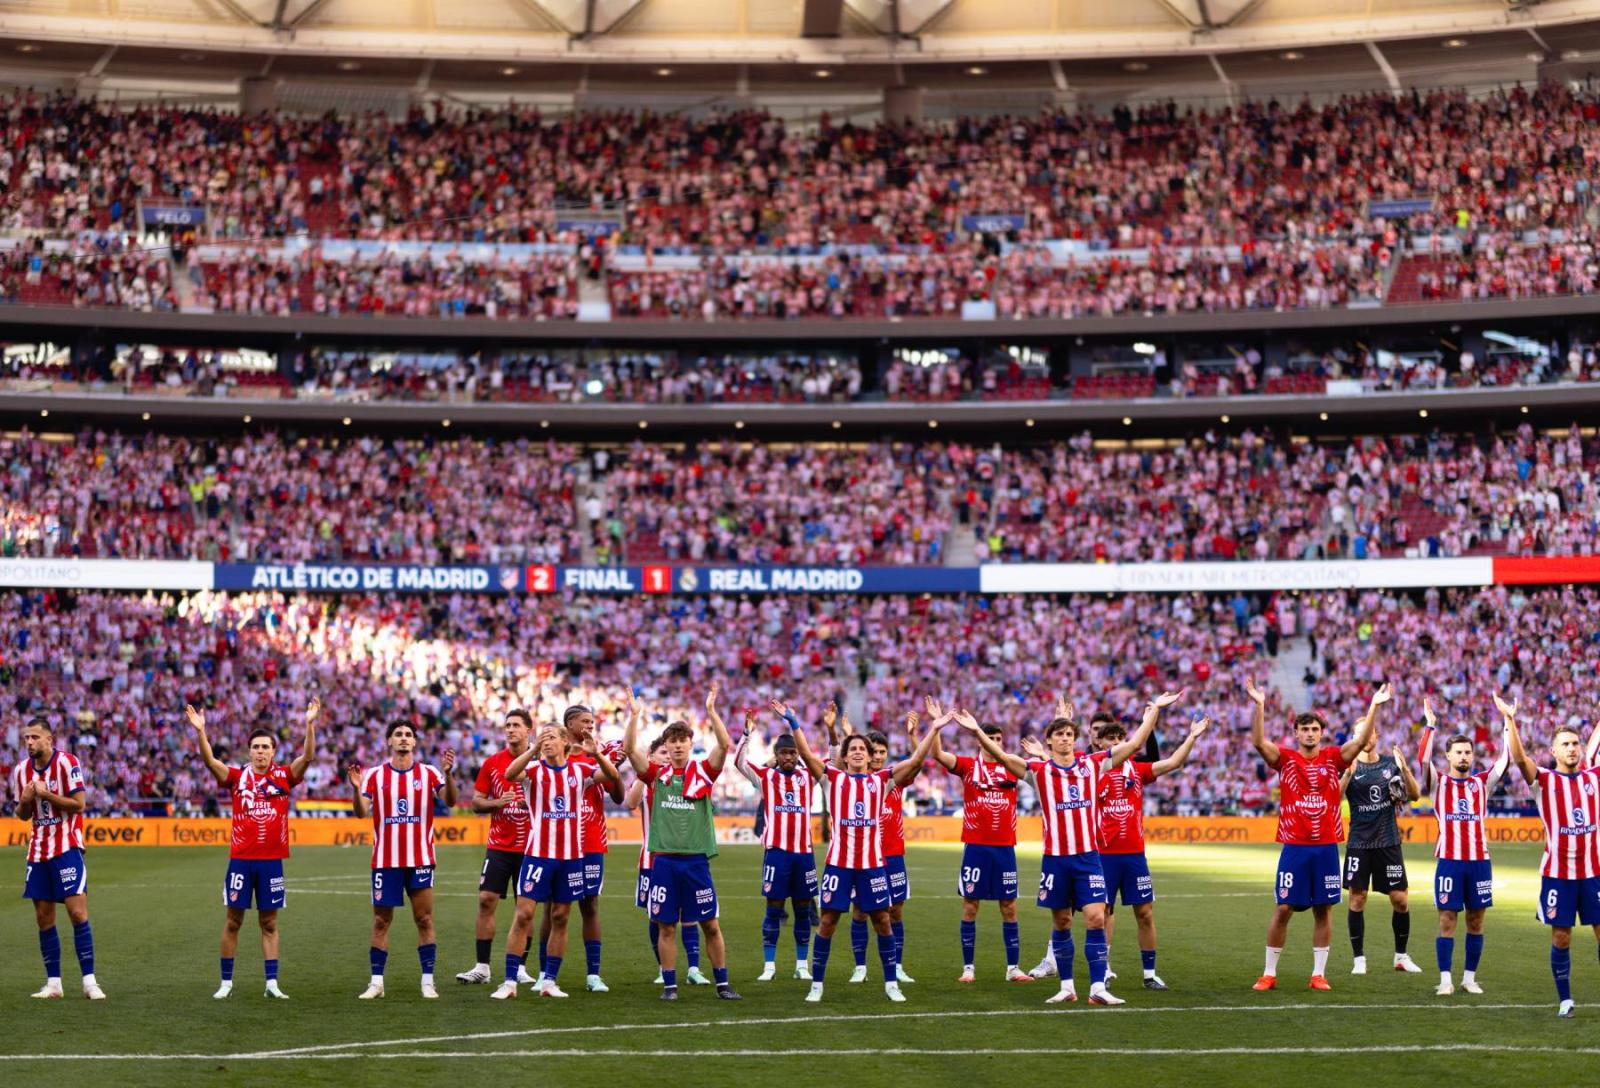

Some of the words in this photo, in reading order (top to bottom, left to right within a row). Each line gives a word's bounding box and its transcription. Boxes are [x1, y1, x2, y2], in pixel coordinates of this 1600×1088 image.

[252, 565, 358, 589] ATLÉTICO
[363, 568, 394, 589] DE
[397, 568, 489, 590] MADRID
[533, 570, 550, 590] 2
[565, 569, 634, 590] FINAL
[652, 570, 663, 590] 1
[709, 569, 768, 590] REAL
[771, 569, 863, 590] MADRID
[668, 794, 687, 803] VISI
[977, 797, 1009, 805] RWANDA
[1109, 798, 1129, 806] VISIT
[248, 808, 277, 816] WANDA
[841, 819, 865, 827] RIYADH
[1560, 826, 1586, 835] RIYADH
[9, 832, 30, 847] LIV
[85, 824, 144, 842] fever
[433, 826, 468, 841] ver
[1347, 856, 1360, 872] 13
[230, 872, 244, 890] 16
[374, 872, 383, 889] 5
[525, 863, 543, 883] 14
[764, 865, 775, 882] 11
[963, 866, 980, 882] 30
[1279, 871, 1294, 889] 18
[639, 875, 650, 892] 19
[821, 873, 839, 892] 20
[872, 885, 888, 893] DKV
[891, 879, 906, 888] DKV
[1038, 872, 1055, 891] 24
[1438, 875, 1453, 893] 10
[651, 885, 667, 903] 46
[695, 888, 713, 896] ERGO
[697, 896, 714, 904] DKV
[1547, 889, 1558, 906] 6
